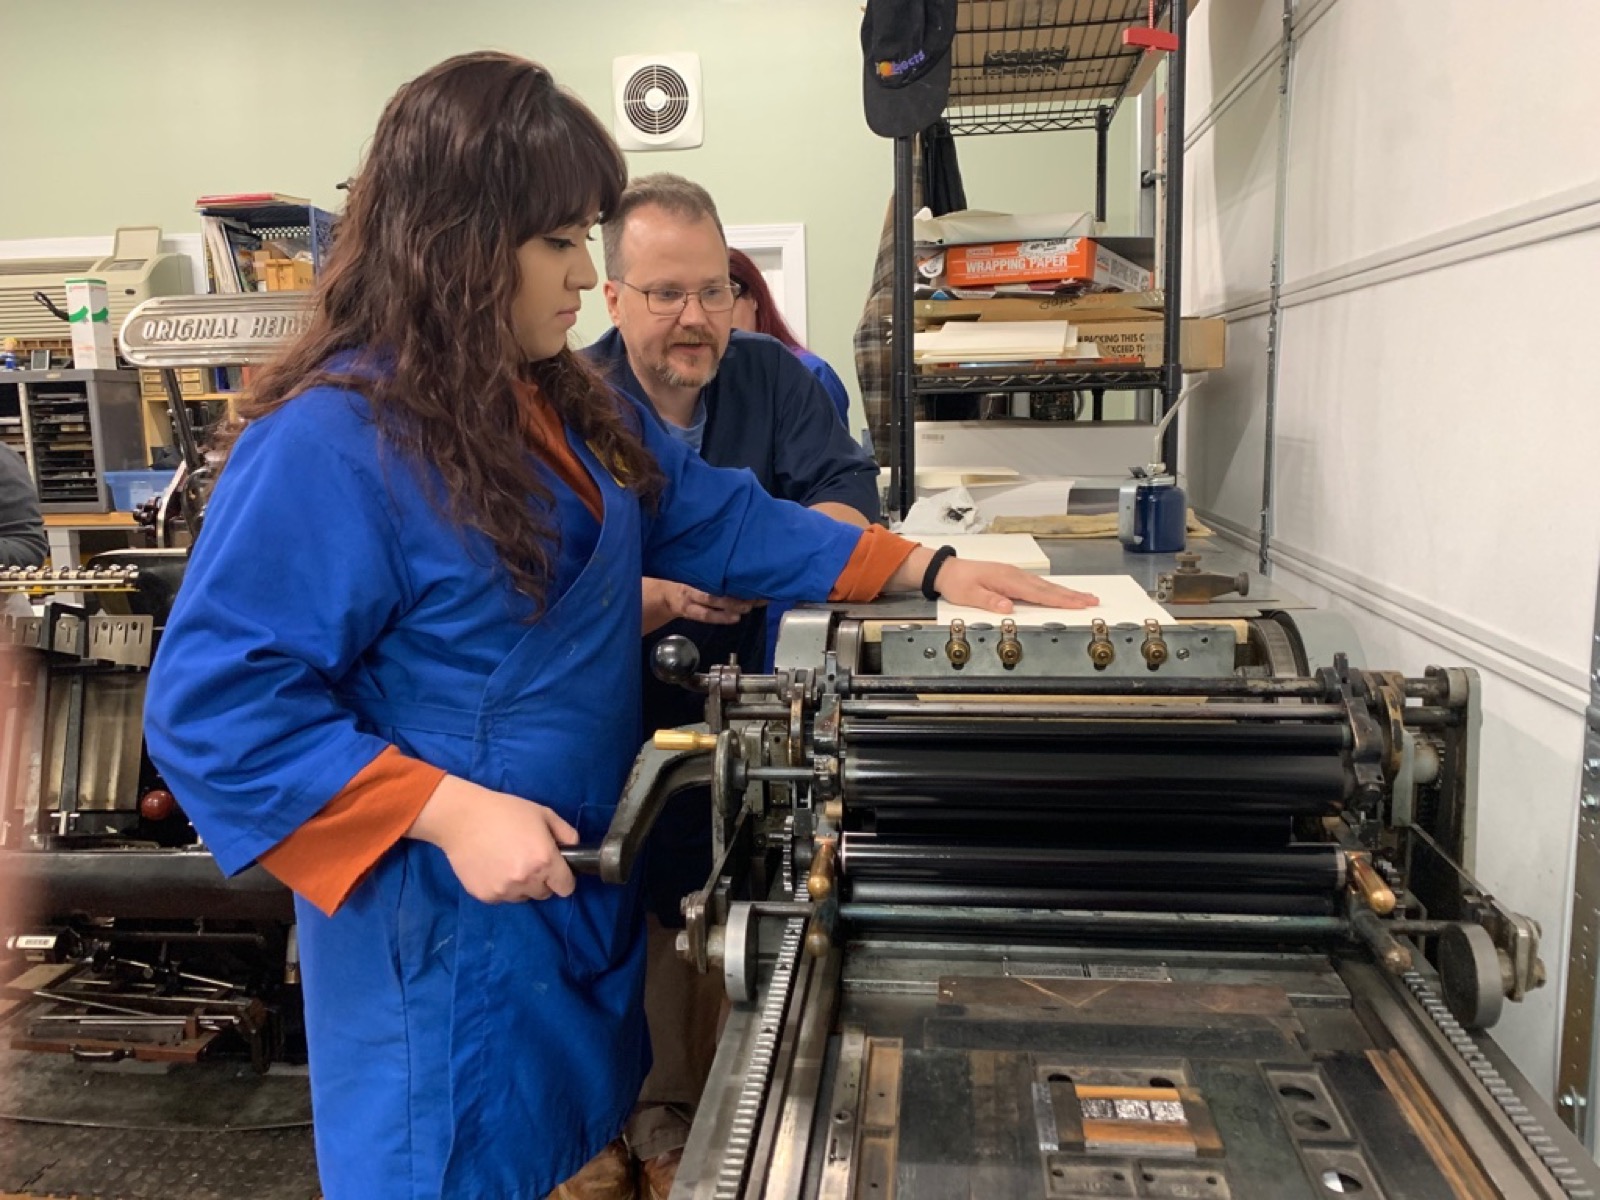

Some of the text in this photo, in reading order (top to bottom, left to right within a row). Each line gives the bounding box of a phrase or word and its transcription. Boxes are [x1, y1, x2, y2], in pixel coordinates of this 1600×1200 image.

[966, 255, 1068, 273] WRAPPING PAPER
[142, 318, 239, 341] ORIGINAL
[1121, 333, 1138, 343] THIS
[1106, 344, 1135, 354] XCEED
